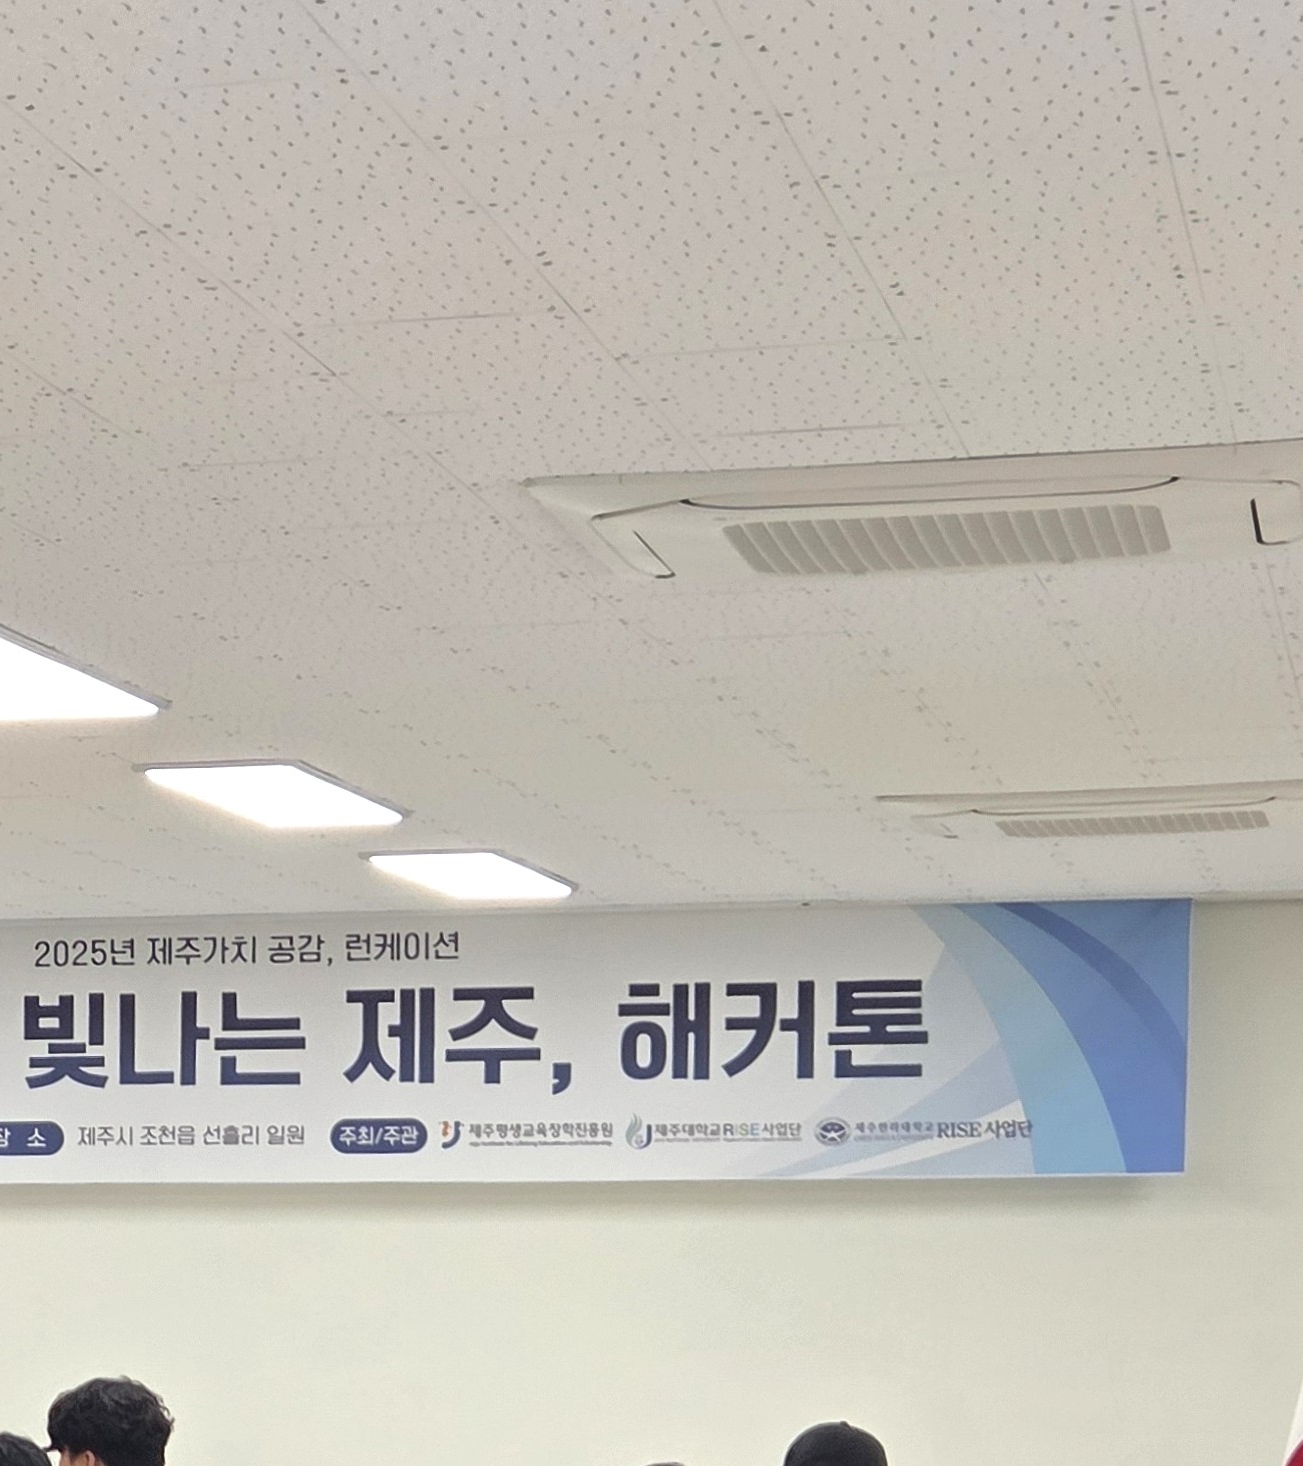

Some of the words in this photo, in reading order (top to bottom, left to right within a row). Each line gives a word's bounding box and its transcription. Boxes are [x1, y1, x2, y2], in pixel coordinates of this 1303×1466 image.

[34, 938, 136, 967] 2025년
[146, 936, 257, 966] 제주가치
[268, 934, 333, 968] 공감,
[345, 931, 460, 962] 런케이션
[23, 991, 307, 1090] 빛나는
[343, 986, 572, 1096] 제주,
[618, 979, 929, 1081] 해커톤
[77, 1125, 134, 1147] 제주시
[139, 1125, 196, 1147] 조천읍
[267, 1124, 306, 1146] 일원
[338, 1124, 420, 1147] 주최/주관
